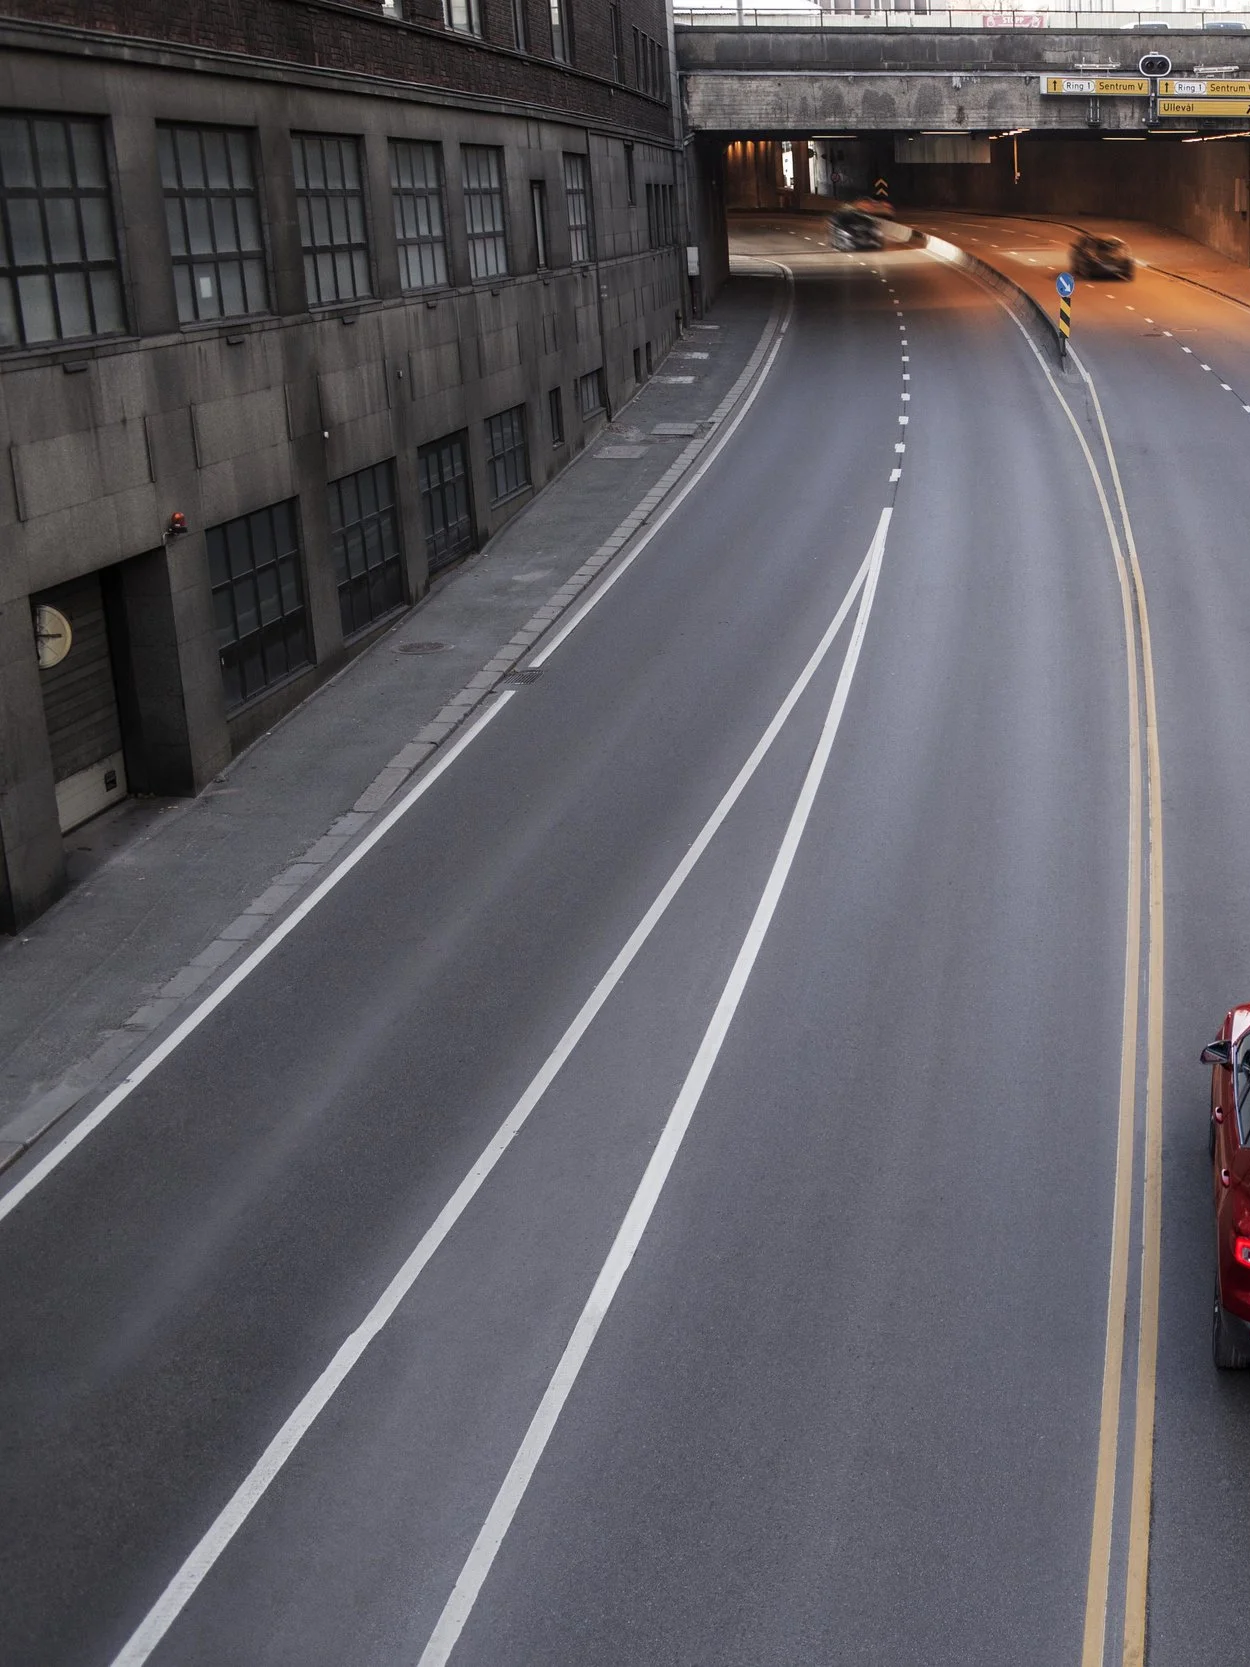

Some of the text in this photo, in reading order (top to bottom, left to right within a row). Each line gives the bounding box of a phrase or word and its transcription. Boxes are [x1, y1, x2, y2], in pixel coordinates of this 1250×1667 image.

[1066, 82, 1144, 91] Ring 1 Sentrum V
[1178, 83, 1196, 92] Ring
[1198, 84, 1202, 92] 1
[1210, 83, 1246, 92] Sentrum
[1163, 102, 1194, 112] Ullevål
